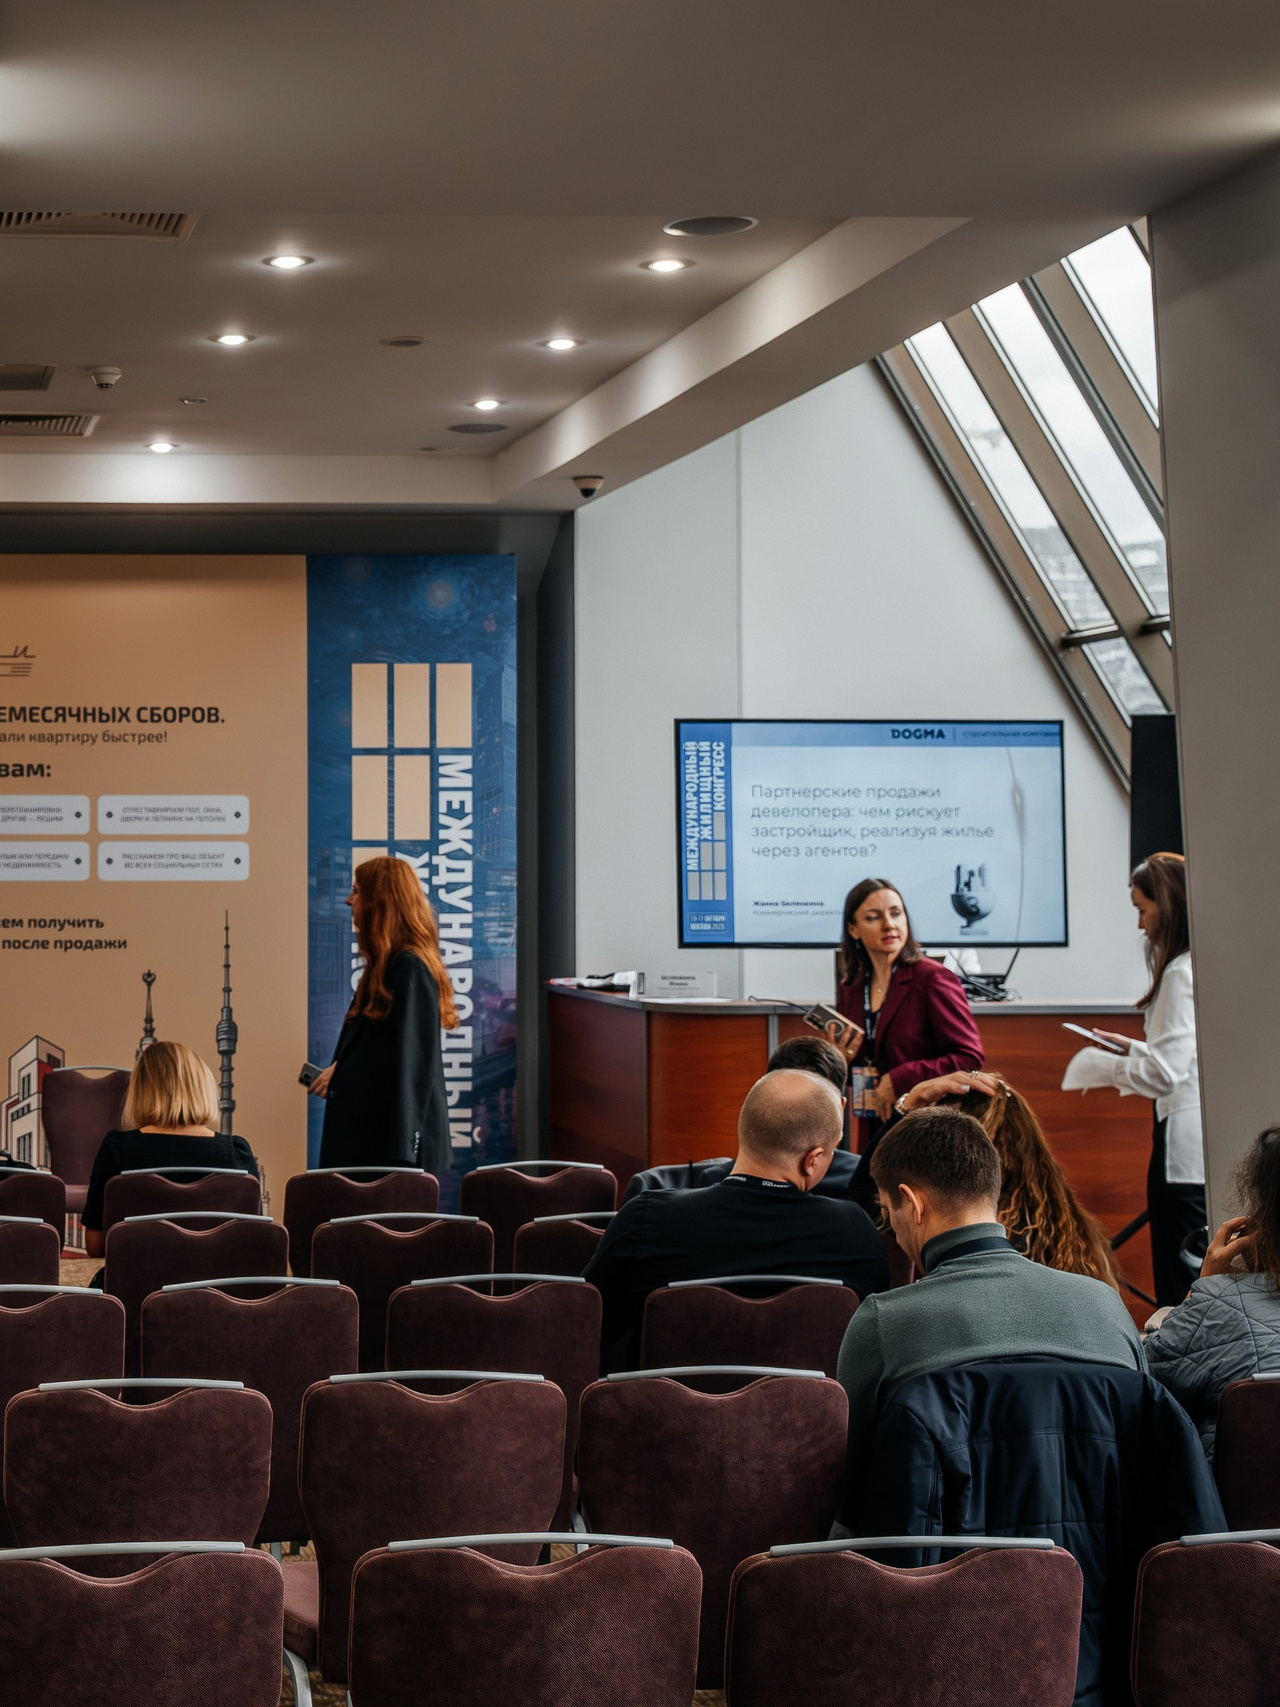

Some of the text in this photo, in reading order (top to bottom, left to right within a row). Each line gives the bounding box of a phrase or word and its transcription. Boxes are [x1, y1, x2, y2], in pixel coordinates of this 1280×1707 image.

[136, 706, 225, 723] СБОРОВ.
[29, 733, 98, 746] квартиру
[102, 730, 168, 745] быстрее!
[891, 729, 946, 740] DOGMA
[713, 741, 725, 811] КОНГРЕСС
[696, 741, 713, 840] ЖИЛИЩНЫЙ
[751, 785, 941, 800] Партнерские продажи
[683, 741, 700, 871] МЕЖДУНАРОДНЫЙ
[751, 805, 960, 820] девелопера: чем рискует
[751, 824, 994, 840] застройщик, реализуя жилье
[751, 843, 877, 859] через агентов?
[27, 917, 104, 931] получить
[2, 938, 51, 949] после
[54, 938, 127, 951] продажи
